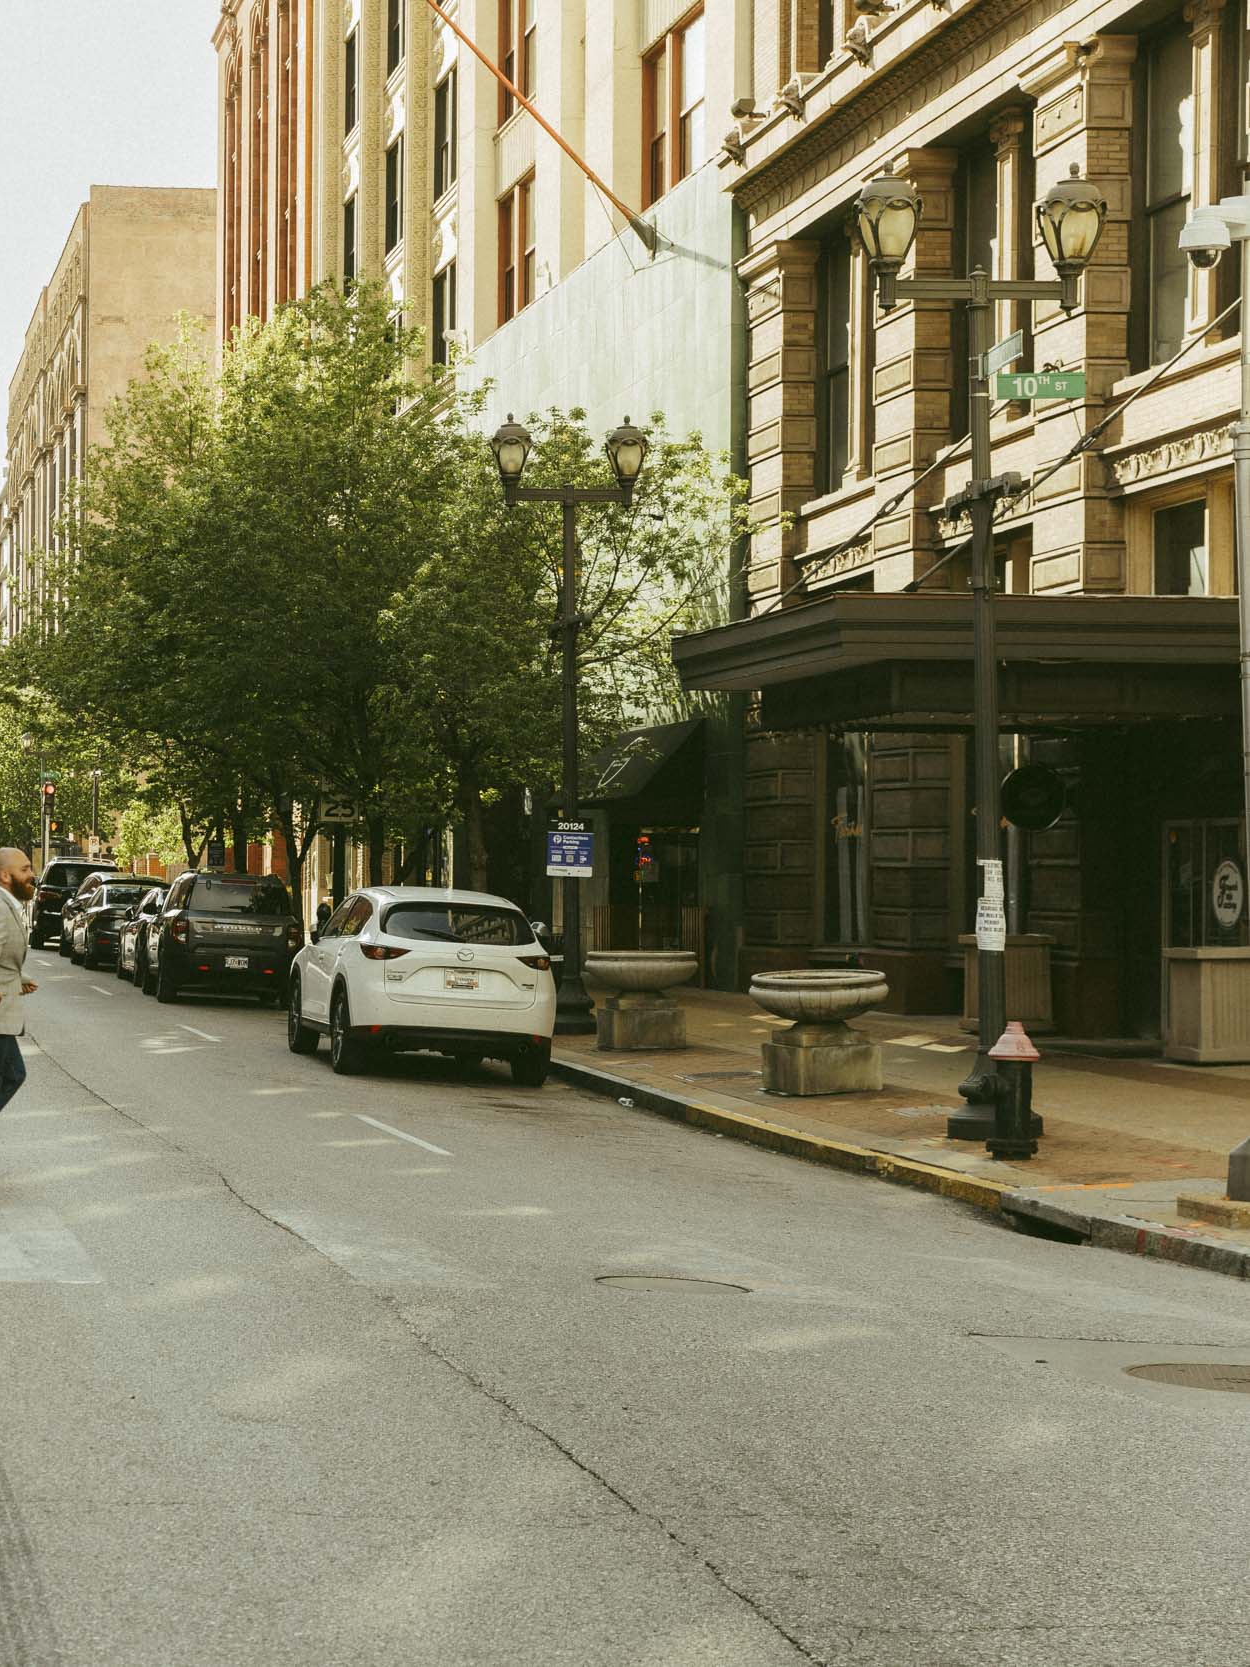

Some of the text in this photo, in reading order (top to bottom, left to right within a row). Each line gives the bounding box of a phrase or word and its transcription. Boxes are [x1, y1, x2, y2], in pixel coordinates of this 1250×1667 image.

[1012, 375, 1068, 397] 10TH ST
[558, 822, 585, 831] 20124
